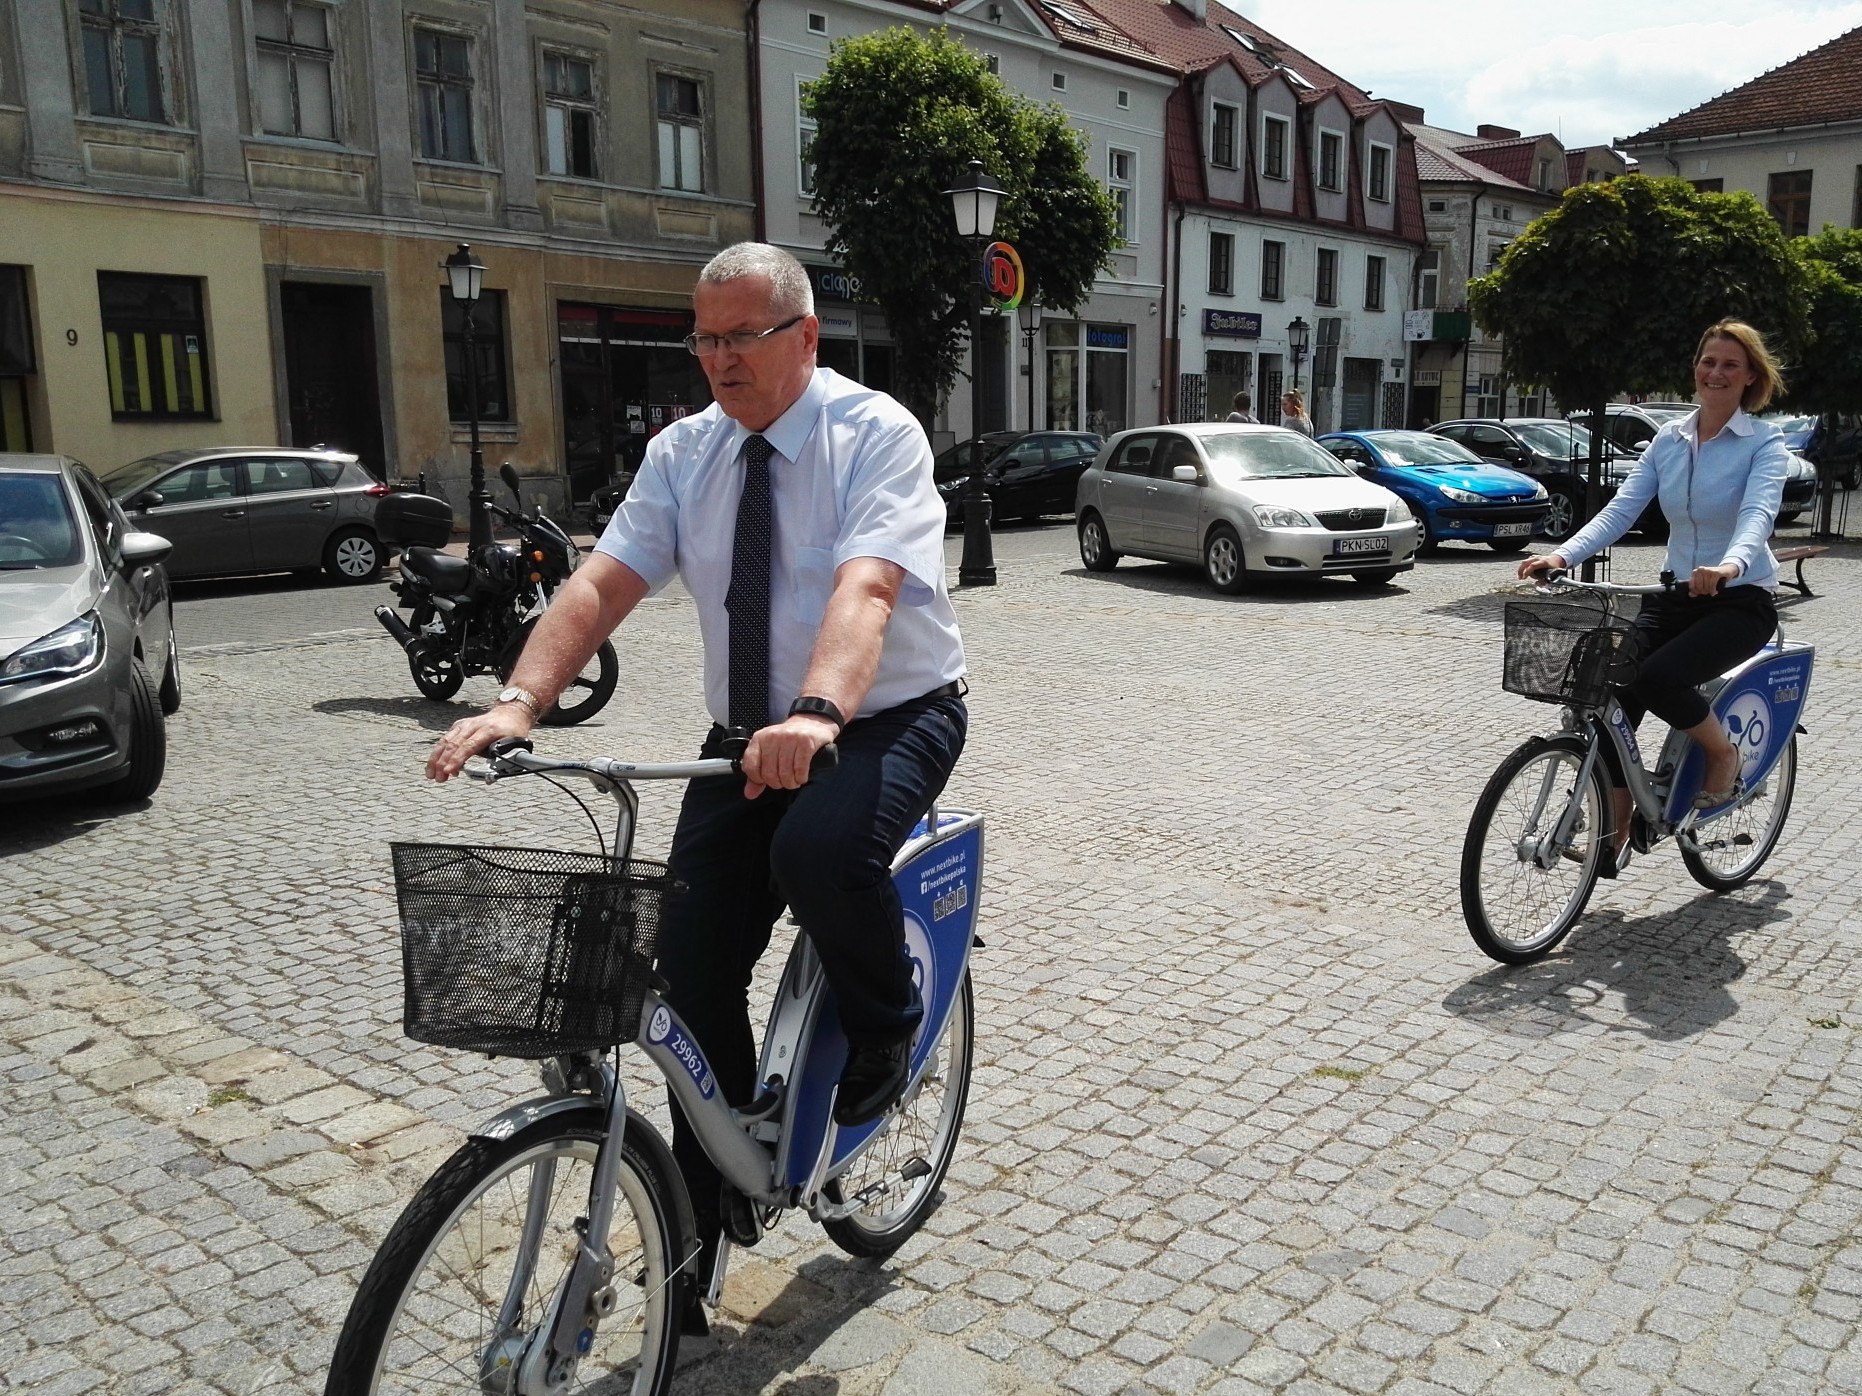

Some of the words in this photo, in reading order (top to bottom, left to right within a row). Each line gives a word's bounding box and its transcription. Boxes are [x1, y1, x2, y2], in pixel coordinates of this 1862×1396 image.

[1210, 312, 1258, 331] Jubiler
[66, 328, 78, 346] 9
[1087, 327, 1127, 347] fotograf
[651, 407, 662, 418] 10
[1498, 525, 1512, 534] PSL
[1342, 540, 1362, 552] PKN
[1364, 538, 1387, 550] SL02
[921, 850, 966, 879] www.nextbike.pl
[671, 1033, 702, 1078] 29962
